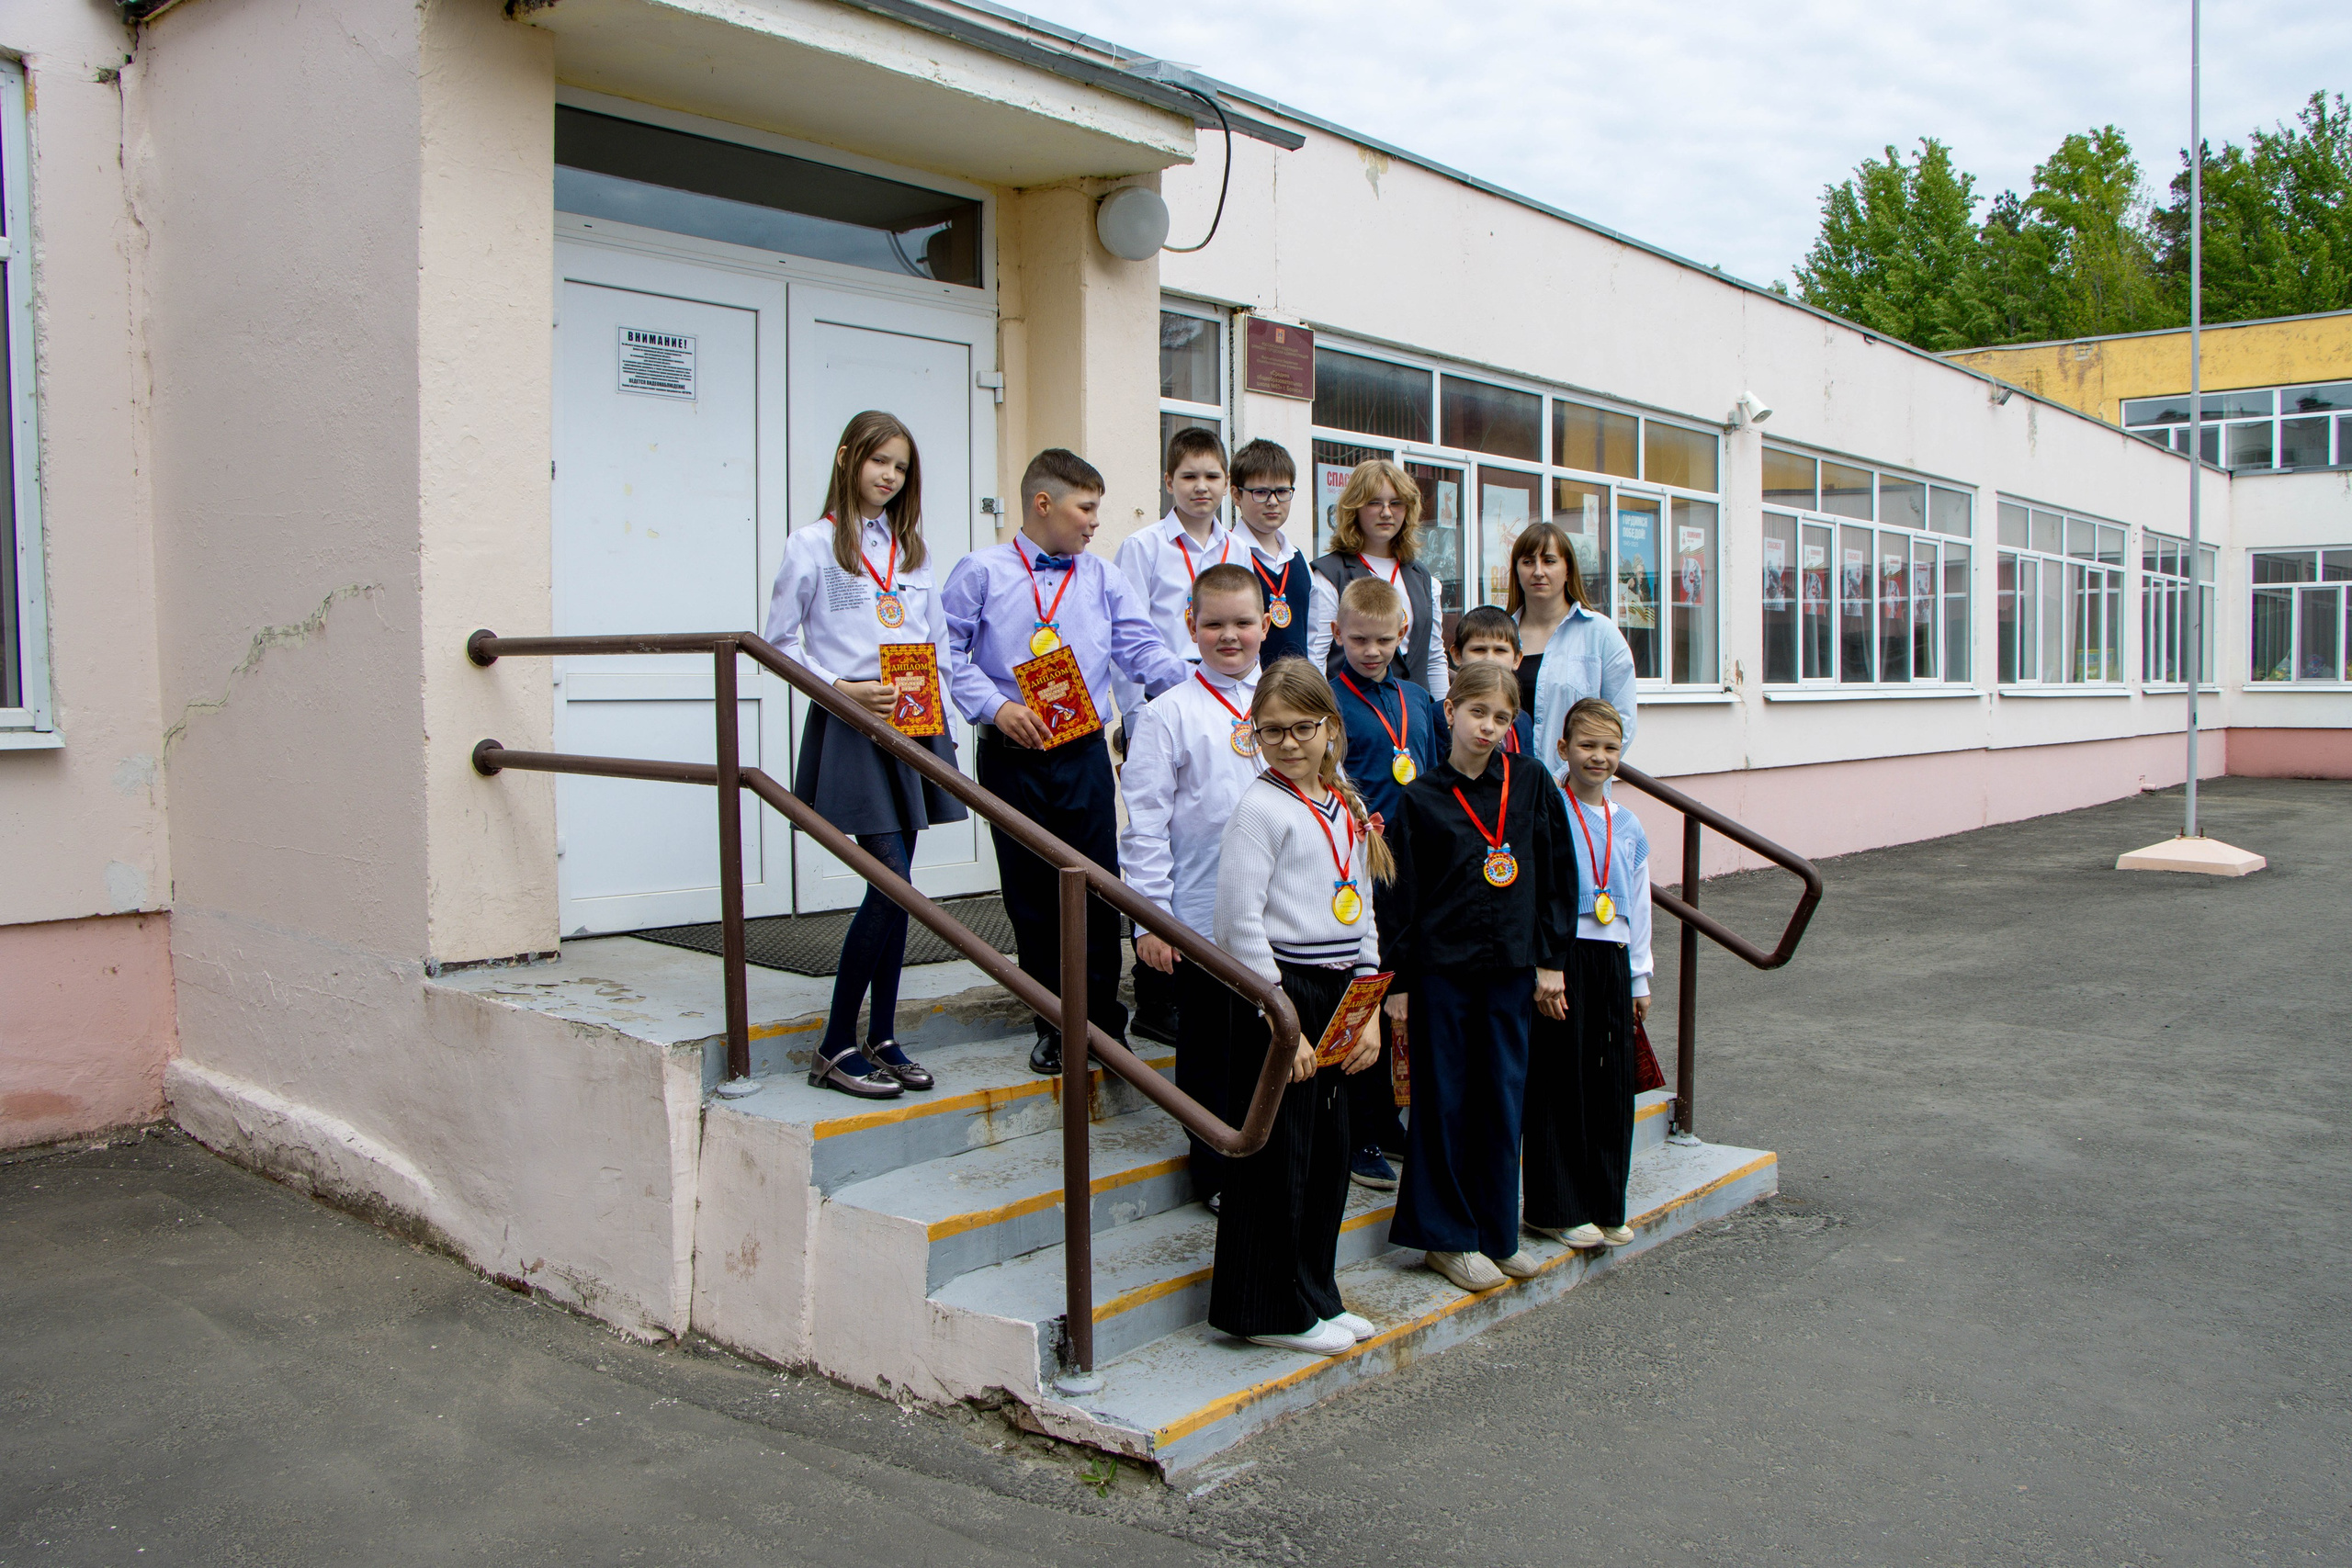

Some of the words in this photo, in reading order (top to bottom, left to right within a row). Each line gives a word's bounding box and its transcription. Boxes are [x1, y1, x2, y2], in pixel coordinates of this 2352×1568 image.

[628, 331, 687, 349] ВНИМАНИЕ!
[1327, 470, 1351, 487] СПАС
[1490, 565, 1508, 588] 80
[1490, 593, 1509, 605] ПОБЕ
[891, 662, 928, 672] ДИПЛОМ
[1031, 667, 1069, 689] ДИПЛОМ
